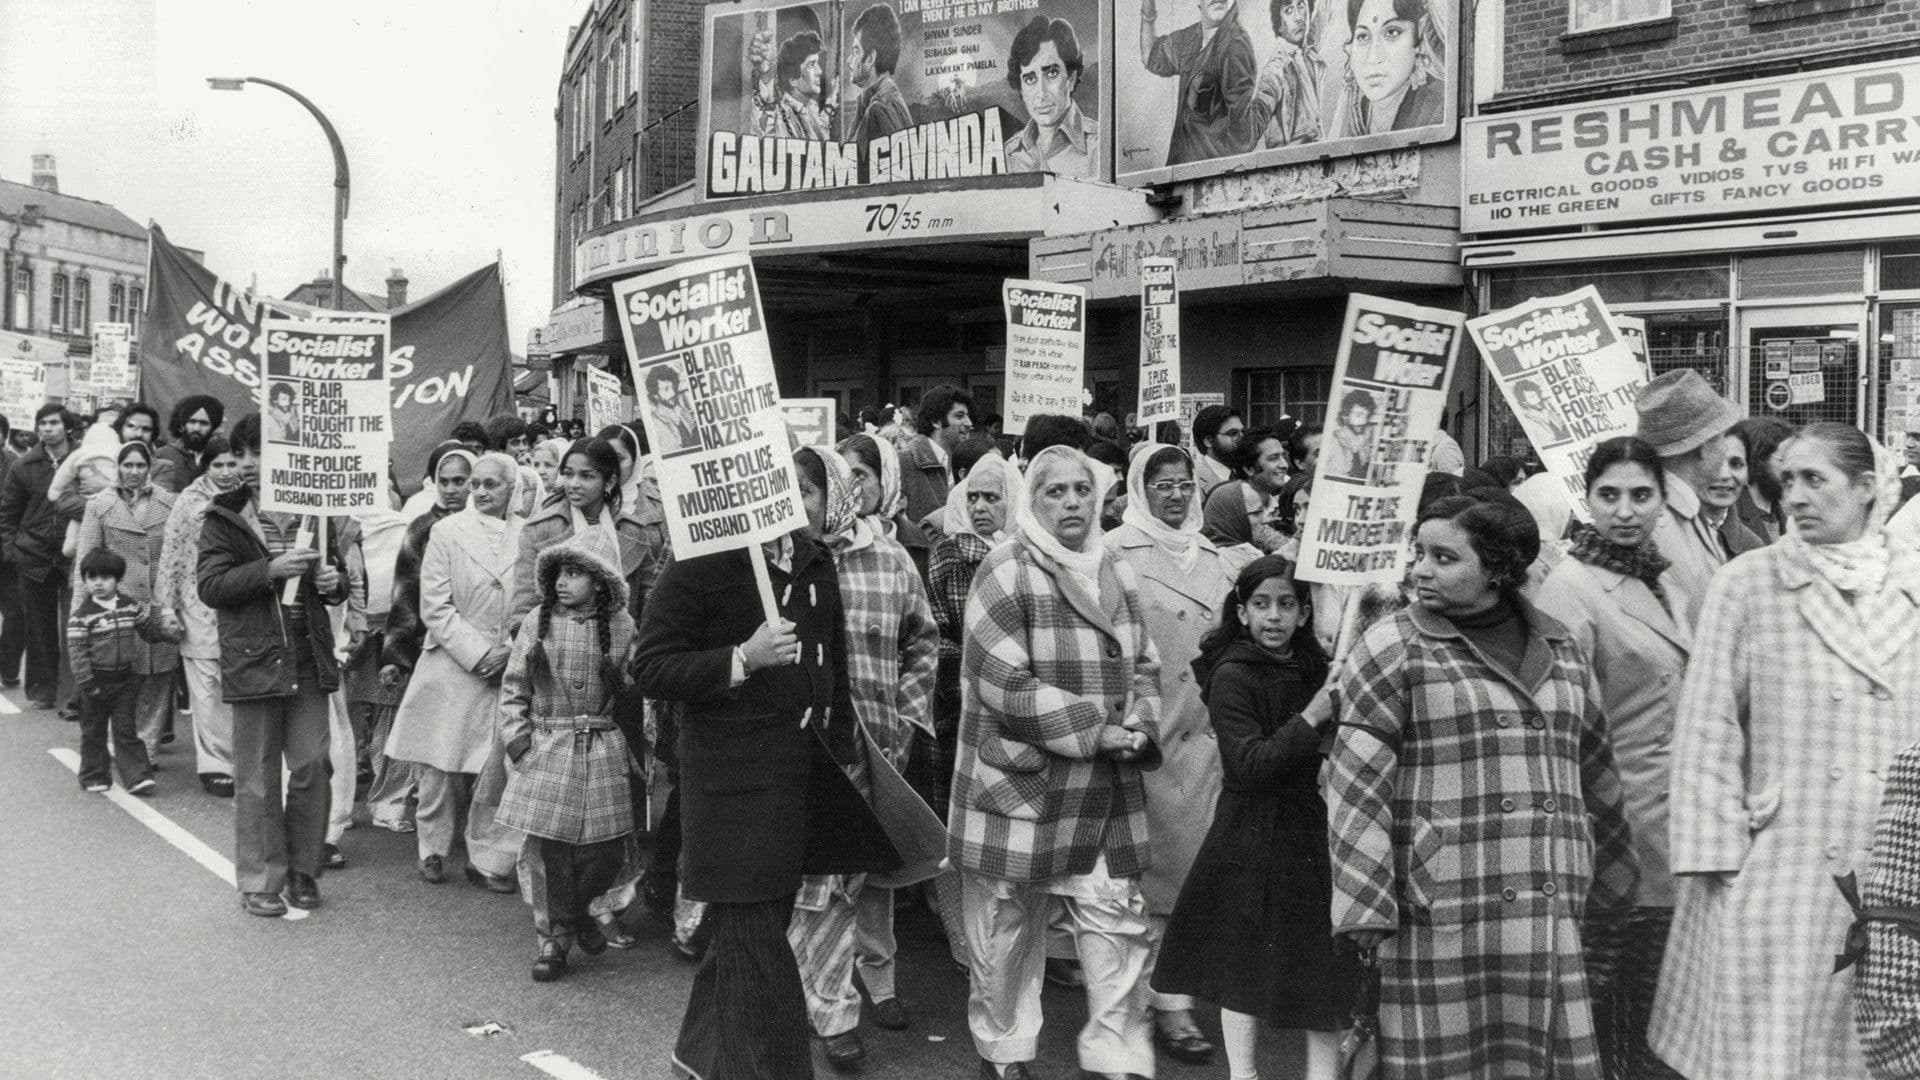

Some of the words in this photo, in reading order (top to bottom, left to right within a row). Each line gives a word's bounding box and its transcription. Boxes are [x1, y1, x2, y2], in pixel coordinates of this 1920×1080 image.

[922, 9, 943, 23] EVEN
[944, 7, 952, 20] IF
[954, 5, 966, 19] HE
[967, 4, 977, 17] IS
[979, 1, 994, 15] MY
[997, 0, 1039, 13] BROTHER
[1487, 72, 1904, 159] RESHMEAD
[711, 131, 858, 193] GAUTAM
[869, 105, 1006, 185] GOVINDA
[1584, 143, 1700, 176] CASH
[1718, 138, 1747, 162] &
[1469, 184, 1581, 205] ELECTRICAL
[1590, 176, 1659, 194] GOODS
[1680, 167, 1745, 186] VIDIOS
[1829, 157, 1848, 171] HI
[1855, 154, 1875, 169] FI
[1650, 190, 1705, 206] GIFTS
[1723, 184, 1791, 201] FANCY
[1803, 174, 1884, 193] GOODS
[1490, 206, 1513, 220] 110
[1518, 204, 1551, 217] THE
[1558, 197, 1620, 214] GREEN
[629, 268, 746, 325] Socialist
[1009, 289, 1077, 313] Socialist
[658, 305, 752, 351] Worker
[1022, 307, 1077, 330] Worker
[1483, 302, 1590, 351] Socialist
[267, 331, 375, 357] Socialist
[682, 341, 735, 376] BLAIR
[1513, 329, 1601, 370] Worker
[290, 354, 375, 379] Worker
[688, 364, 745, 401] PEACH
[1791, 373, 1821, 387] CLOSED
[302, 380, 342, 399] BLAIR
[694, 388, 756, 426] FOUGHT
[754, 382, 776, 412] THE
[302, 398, 347, 415] PEACH
[302, 415, 355, 432] FOUGHT
[358, 415, 383, 431] THE
[287, 452, 311, 471] THE
[313, 455, 362, 472] POLICE
[690, 459, 722, 488] THE
[722, 444, 775, 483] POLICE
[271, 469, 346, 490] MURDERED
[348, 472, 377, 489] HIM
[677, 474, 769, 519] MURDERED
[767, 466, 791, 496] HIM
[274, 489, 323, 507] DISBAND
[325, 493, 347, 507] THE
[349, 492, 374, 506] SPG
[688, 512, 750, 543] DISBAND
[752, 505, 776, 529] THE
[776, 496, 794, 523] SPG
